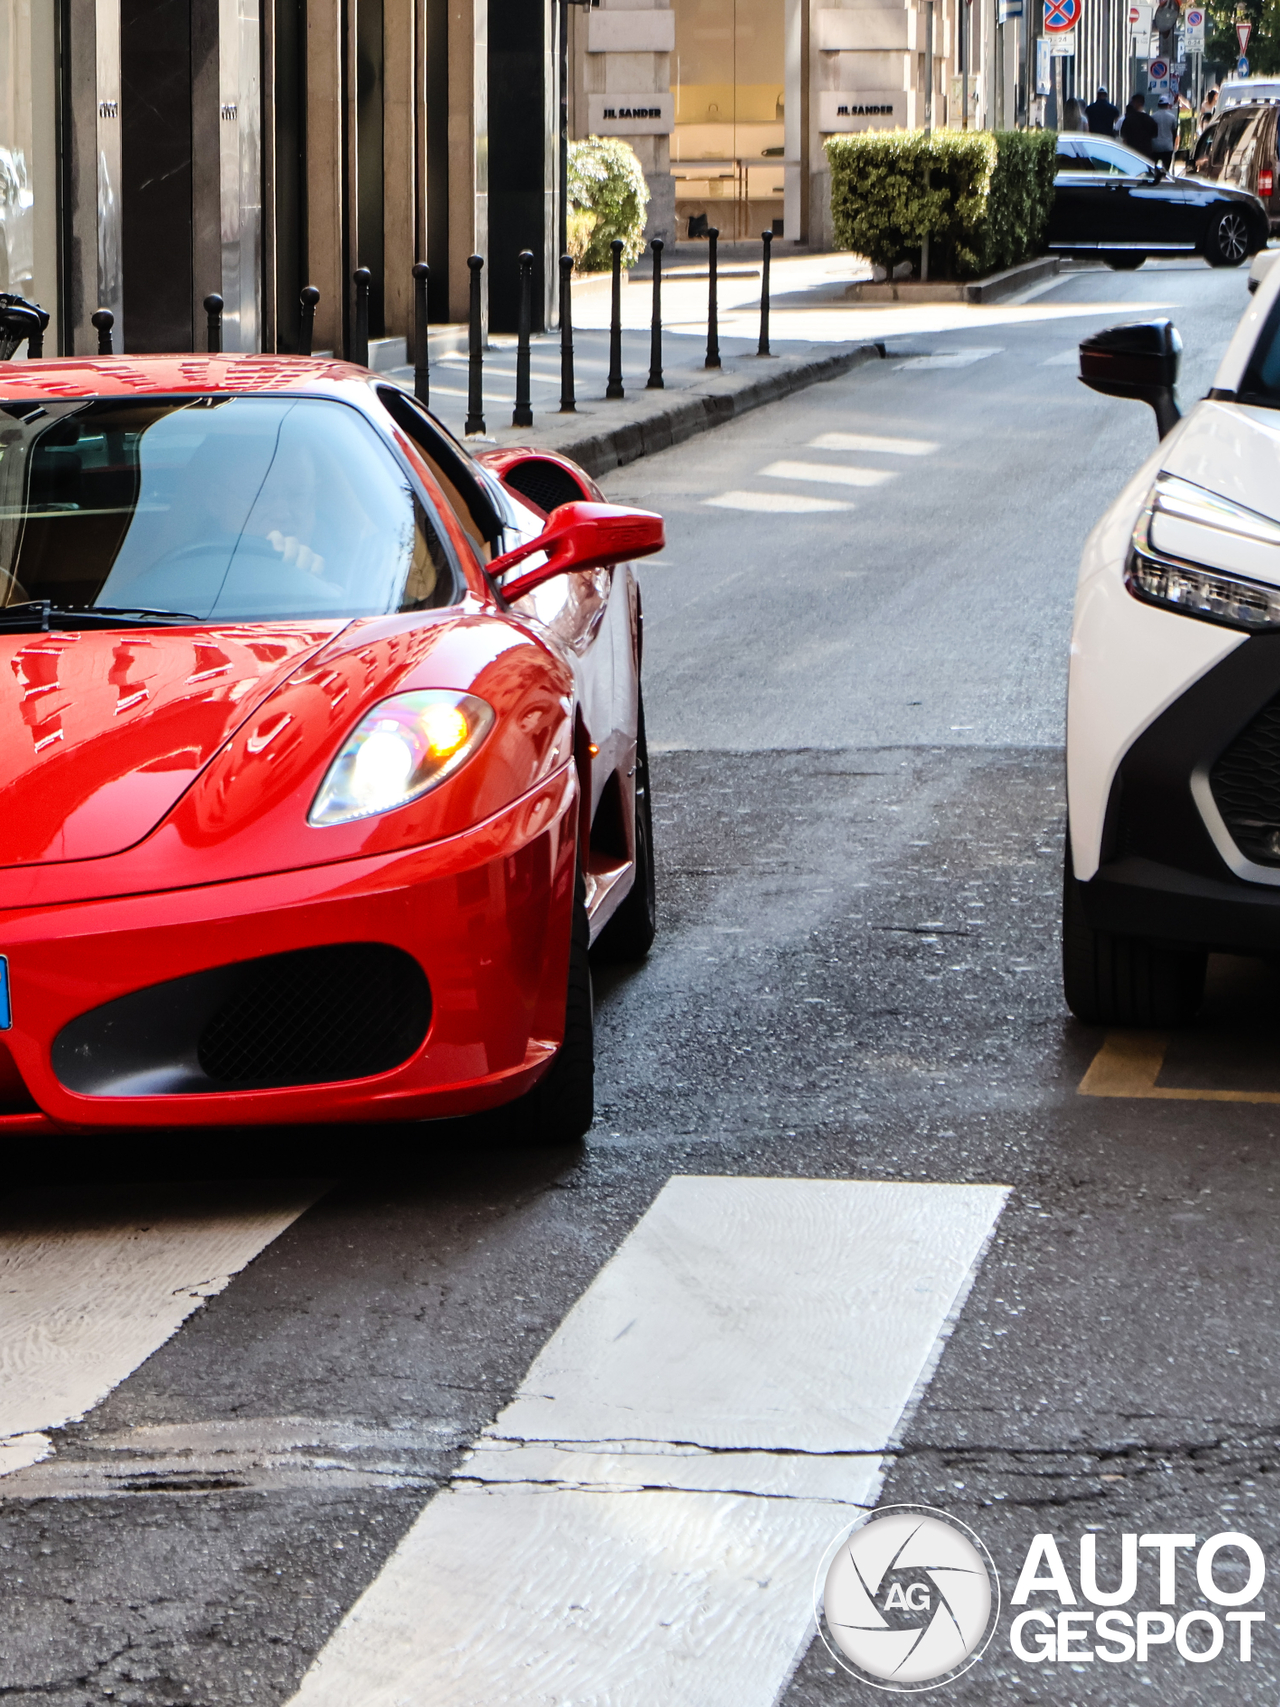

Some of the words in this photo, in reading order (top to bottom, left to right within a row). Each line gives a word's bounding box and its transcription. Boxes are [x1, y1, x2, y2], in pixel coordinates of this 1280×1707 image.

[603, 108, 617, 119] JIL
[619, 108, 661, 119] SANDER
[852, 106, 893, 116] SANDER
